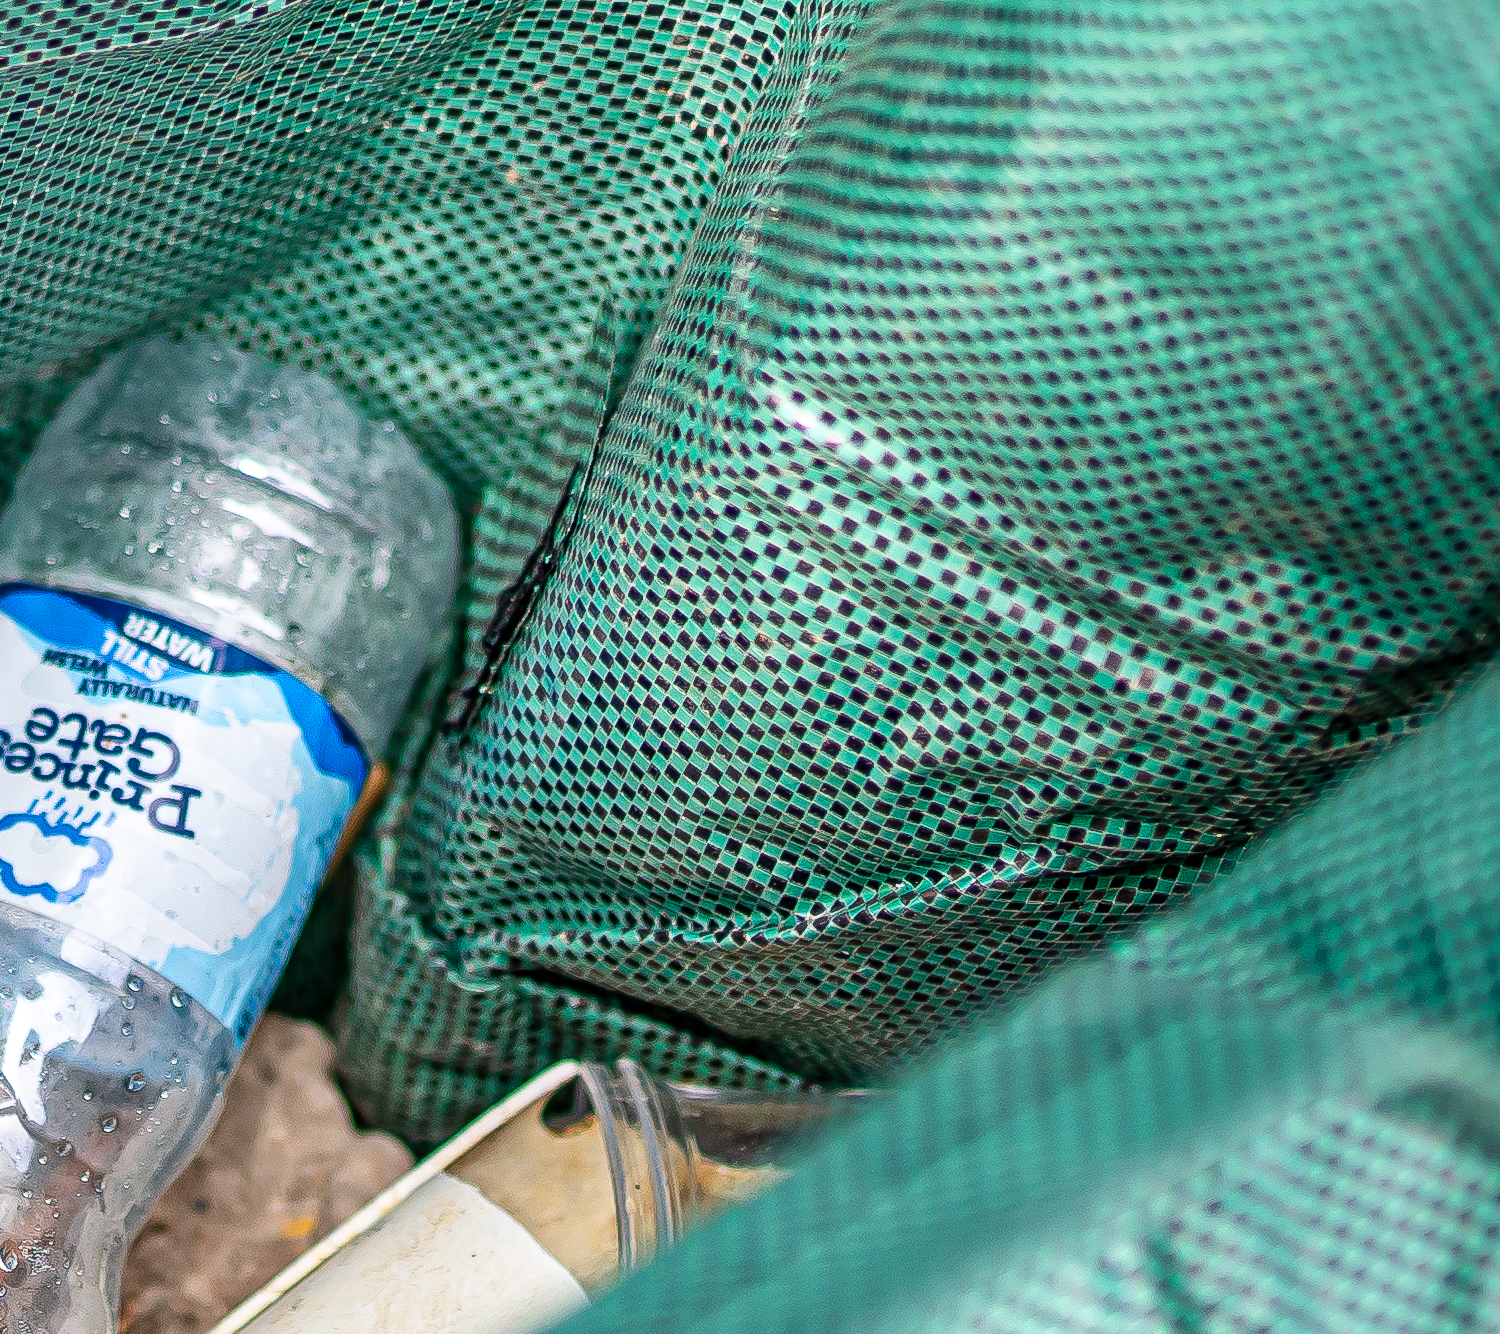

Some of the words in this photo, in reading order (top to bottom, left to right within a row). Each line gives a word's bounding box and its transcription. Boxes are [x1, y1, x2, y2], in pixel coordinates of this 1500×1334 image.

[43, 649, 108, 678] WELSH
[101, 630, 169, 680] STILL
[123, 613, 216, 673] WATER
[77, 678, 199, 714] NATURALLY
[25, 707, 181, 781] Gate
